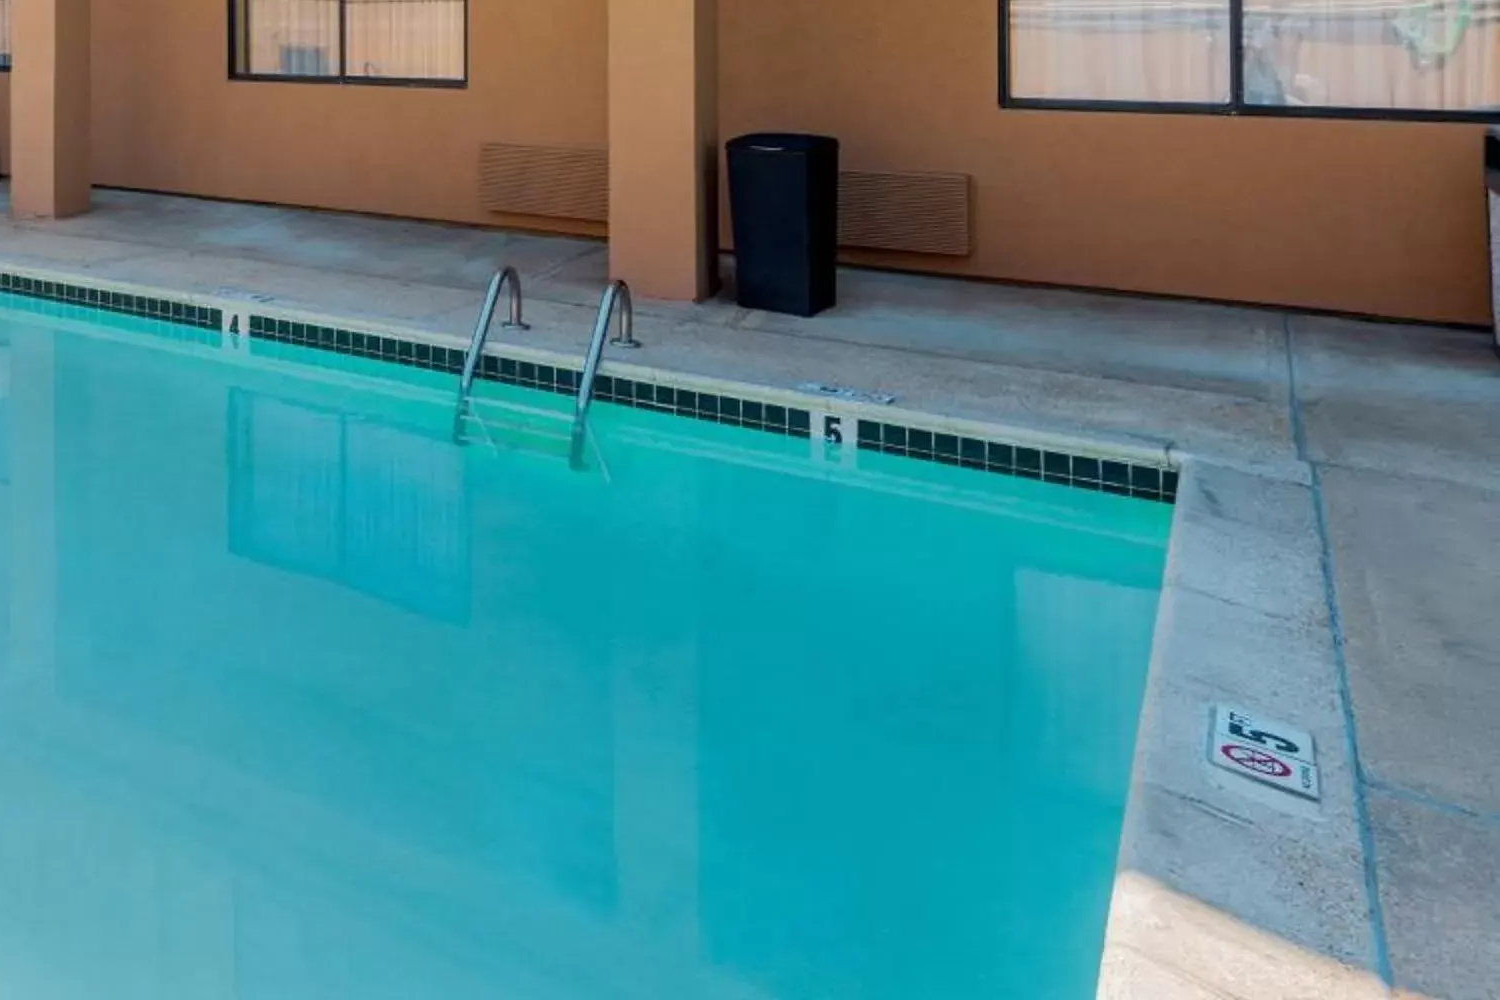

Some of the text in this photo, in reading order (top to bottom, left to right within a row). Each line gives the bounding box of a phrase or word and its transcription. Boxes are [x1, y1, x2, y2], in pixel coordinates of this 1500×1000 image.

[229, 313, 240, 335] 4
[824, 415, 843, 445] 5
[1228, 722, 1300, 753] 5
